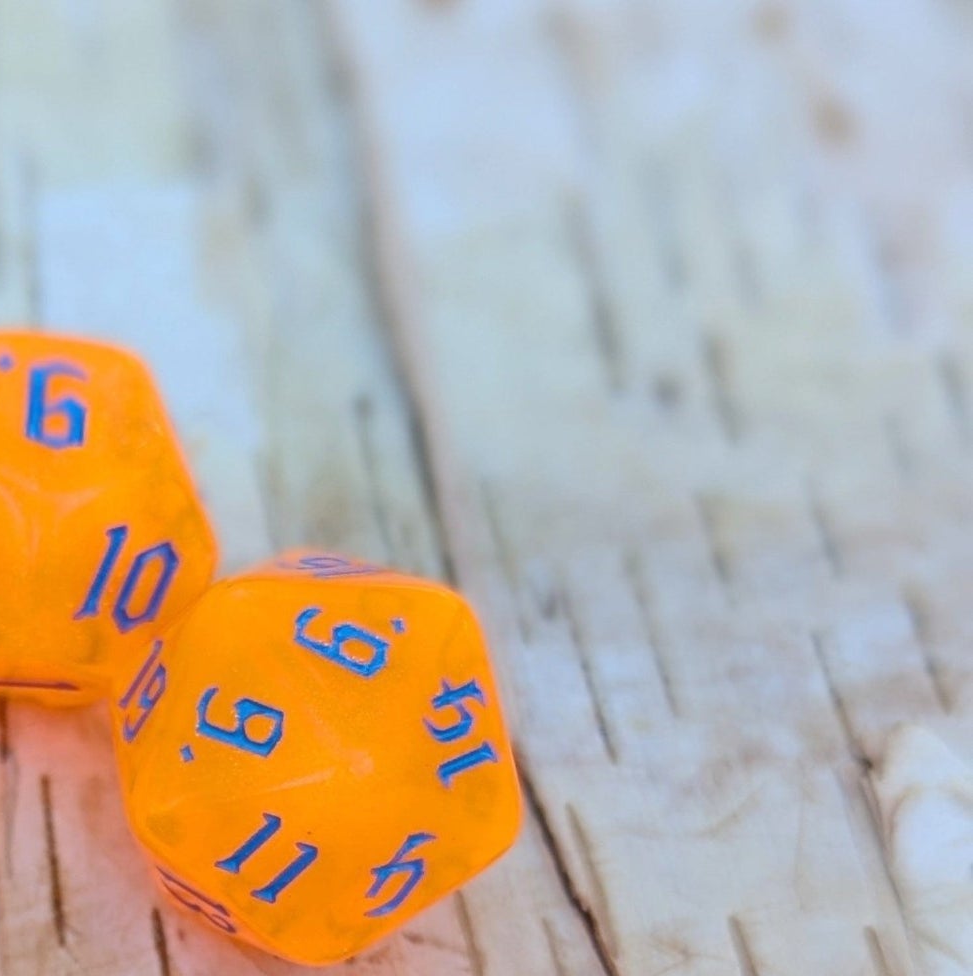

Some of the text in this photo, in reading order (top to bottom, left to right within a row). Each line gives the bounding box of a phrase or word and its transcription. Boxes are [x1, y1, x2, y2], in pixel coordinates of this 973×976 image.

[73, 525, 179, 634] 10
[423, 677, 498, 789] 14
[215, 813, 318, 904] 11
[364, 832, 437, 918] 4
